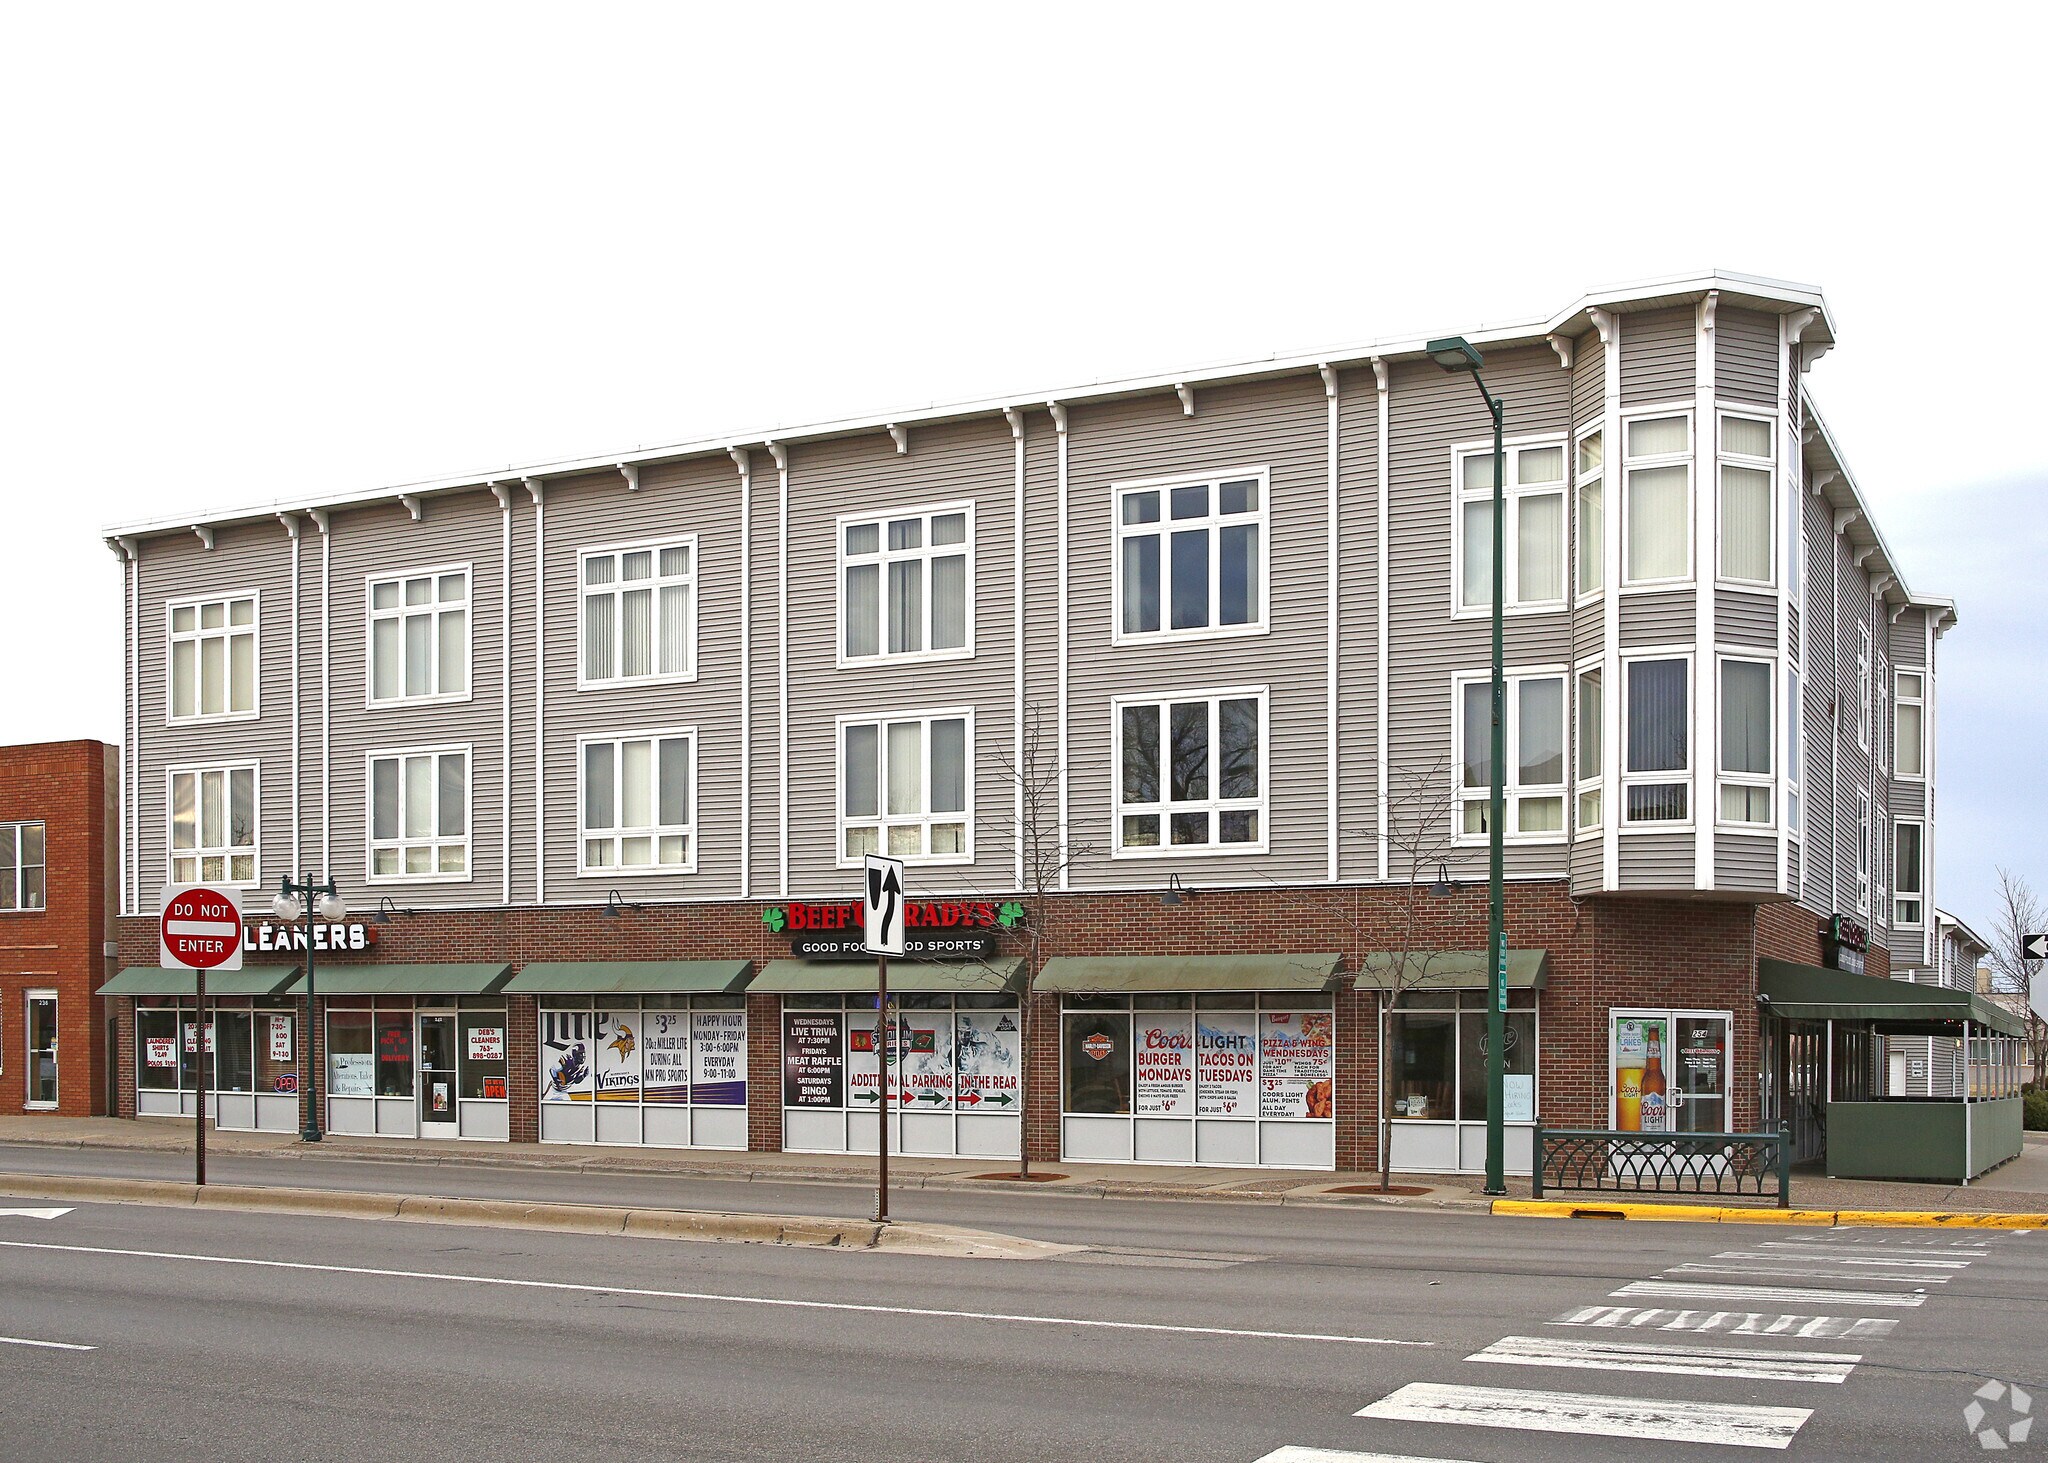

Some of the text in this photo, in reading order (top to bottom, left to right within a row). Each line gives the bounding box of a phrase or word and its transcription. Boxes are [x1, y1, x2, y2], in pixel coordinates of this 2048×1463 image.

[174, 904, 228, 918] DO NOT
[788, 902, 850, 928] BEEF
[904, 902, 994, 926] RADYS
[244, 922, 366, 950] LEANERS
[180, 940, 224, 953] ENTER
[803, 942, 838, 952] GOOD
[843, 942, 866, 952] FOO
[928, 940, 980, 951] SPORTS
[696, 1015, 742, 1026] HAPPY HOUR
[694, 1031, 746, 1041] MONDAY-FRIDAY
[791, 1028, 837, 1036] LIVE TRIVIA
[658, 1037, 676, 1049] MILLER
[677, 1037, 687, 1049] LITE
[1145, 1028, 1246, 1049] Coors LIGHT
[651, 1053, 682, 1065] DURING ALL
[704, 1057, 735, 1067] EVERYDAY
[812, 1057, 841, 1065] RAFFLE
[1138, 1053, 1181, 1065] BURGER
[1199, 1054, 1253, 1067] TACOS ON
[656, 1069, 666, 1081] PRO
[668, 1069, 687, 1081] SPORTS
[1138, 1068, 1191, 1081] MONDAYS
[1199, 1070, 1253, 1082] TUESDAYS
[275, 1078, 297, 1090] OPEN
[851, 1074, 1017, 1089] ADDITINAL PARKING IN THE REAR
[486, 1086, 505, 1098] OPEN
[802, 1087, 827, 1095] BINGO
